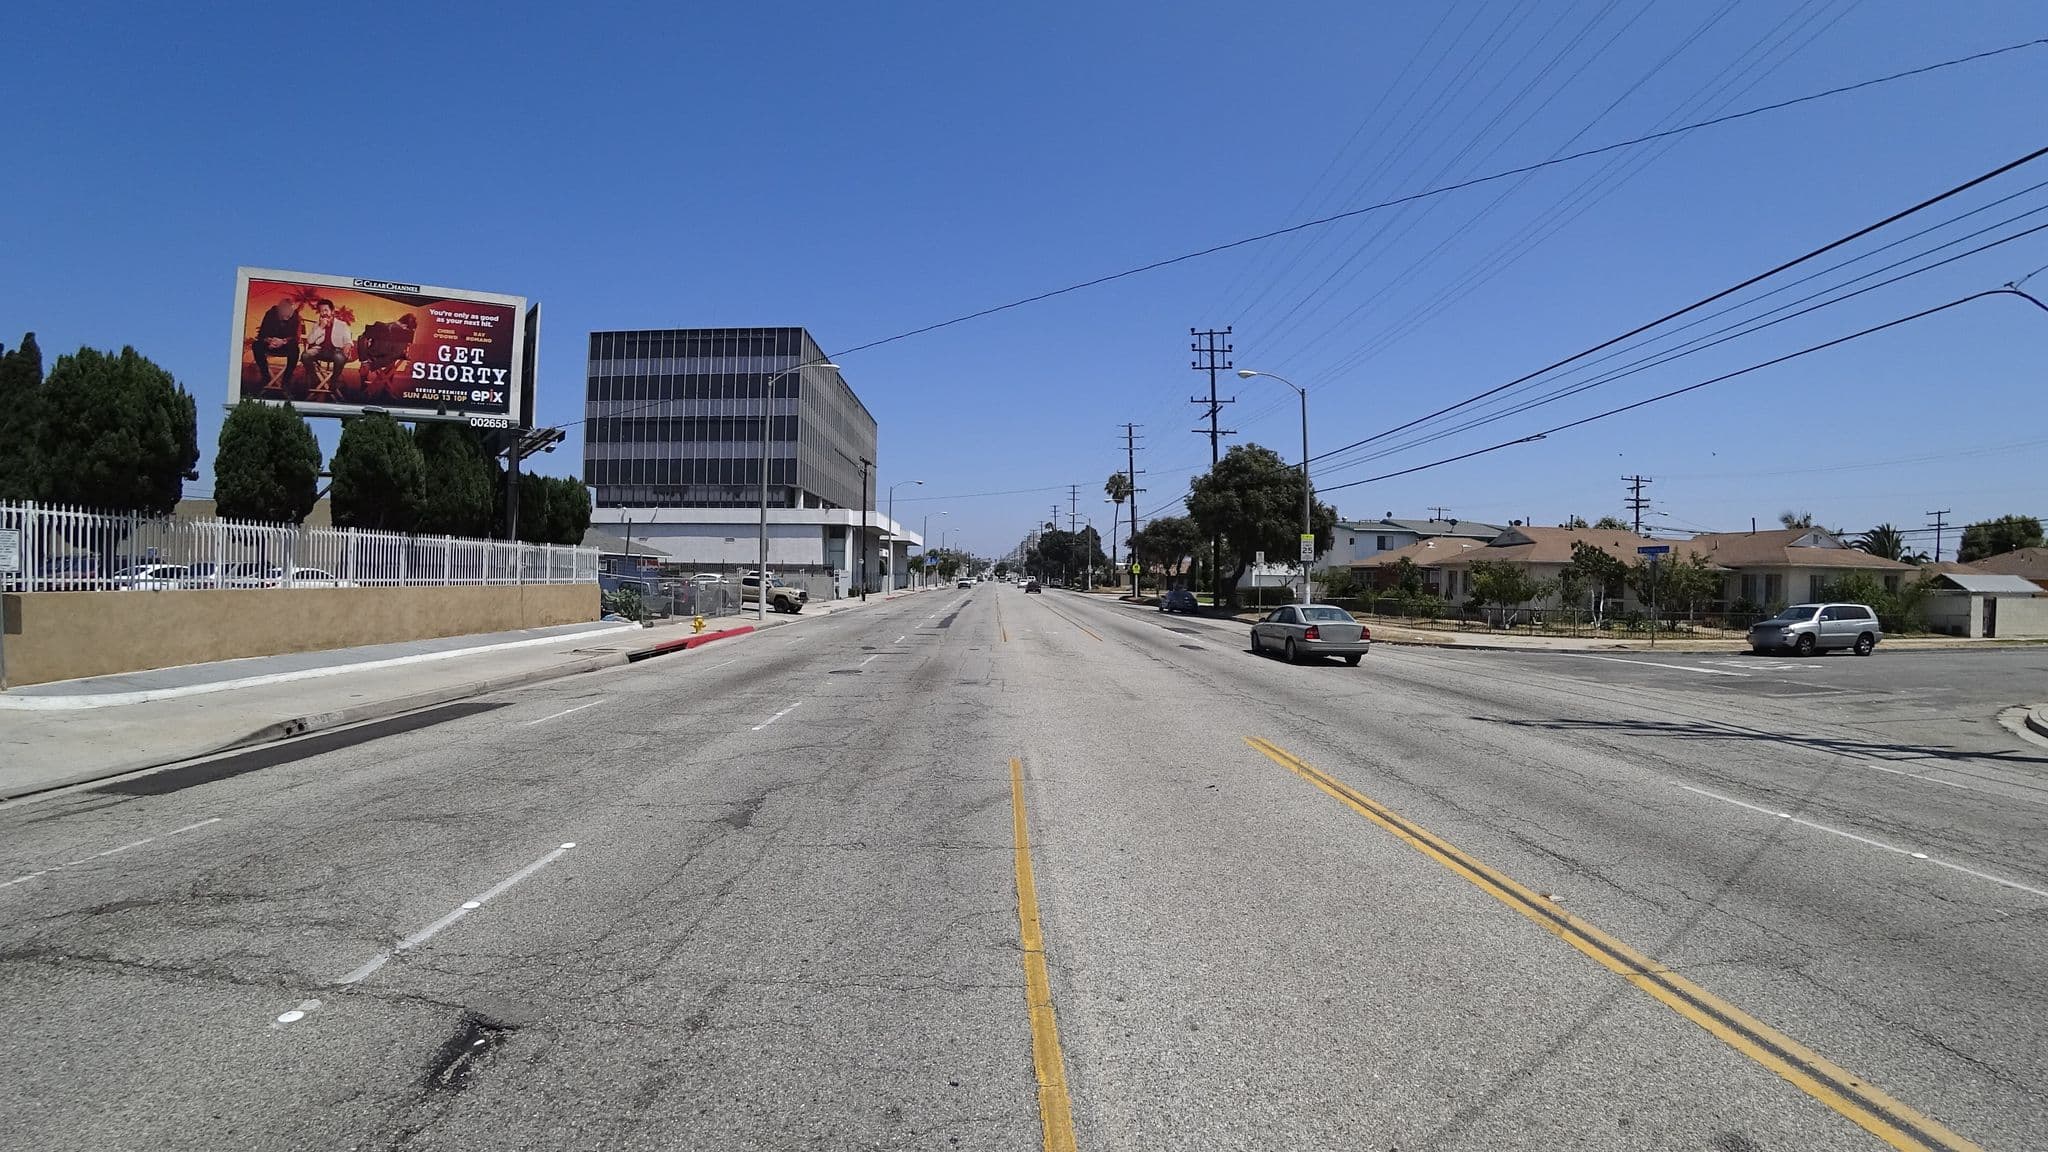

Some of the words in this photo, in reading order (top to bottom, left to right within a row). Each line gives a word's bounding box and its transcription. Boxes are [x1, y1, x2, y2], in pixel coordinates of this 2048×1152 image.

[429, 309, 453, 317] You're
[438, 345, 484, 364] GET
[412, 362, 508, 385] SHORTY
[403, 391, 420, 399] SUN
[471, 388, 503, 403] epix
[470, 418, 508, 429] 002658
[1302, 546, 1312, 554] 25
